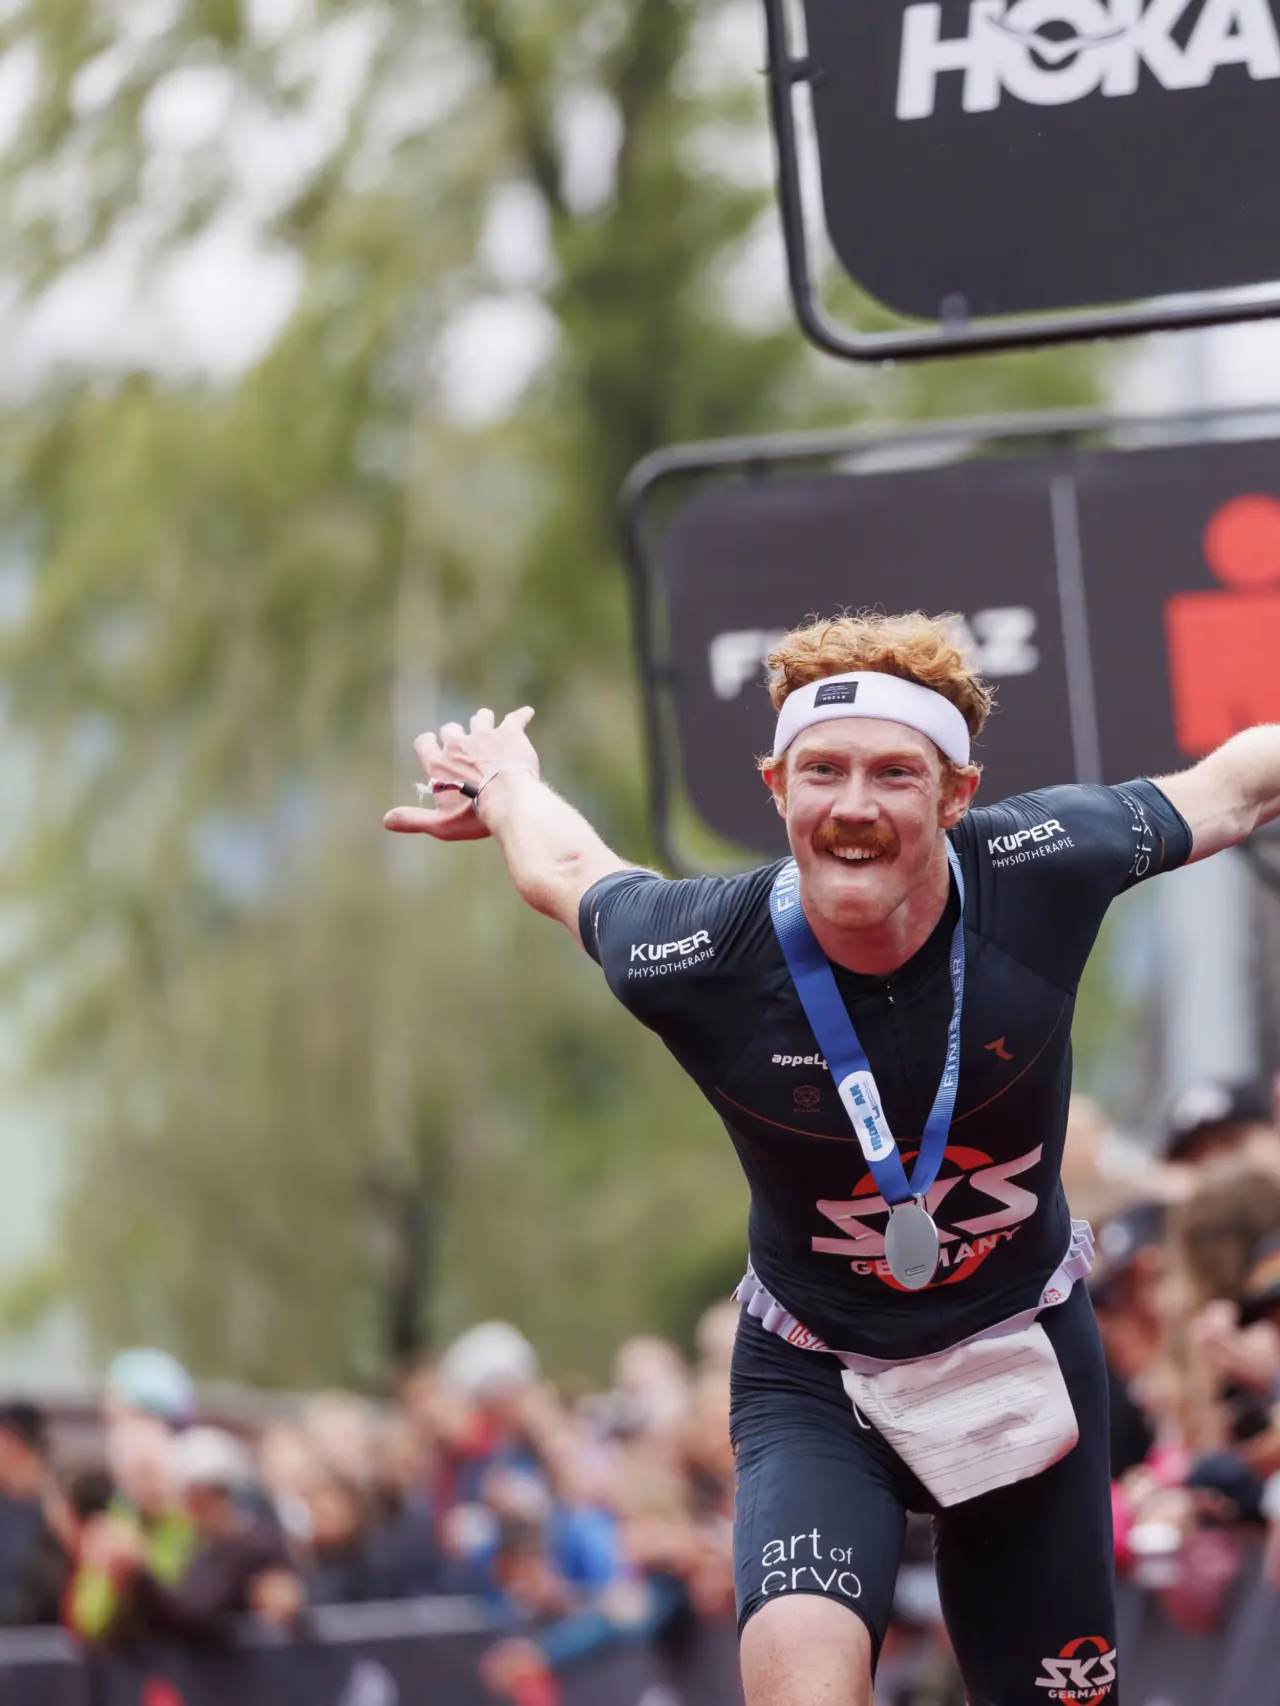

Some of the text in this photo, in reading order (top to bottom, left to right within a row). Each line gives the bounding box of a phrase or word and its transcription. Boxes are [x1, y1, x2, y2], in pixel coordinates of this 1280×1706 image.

[987, 819, 1066, 855] KUPER
[992, 836, 1075, 868] PHYSIOTHERAPIE
[627, 946, 715, 979] PHYSIOTHERAPIE
[630, 929, 712, 962] KUPER
[849, 1083, 883, 1152] IRONAN
[850, 1225, 1022, 1276] GEANY
[761, 1528, 853, 1567] art of
[1034, 1647, 1117, 1689] SKS
[1048, 1683, 1112, 1699] GERMANY
